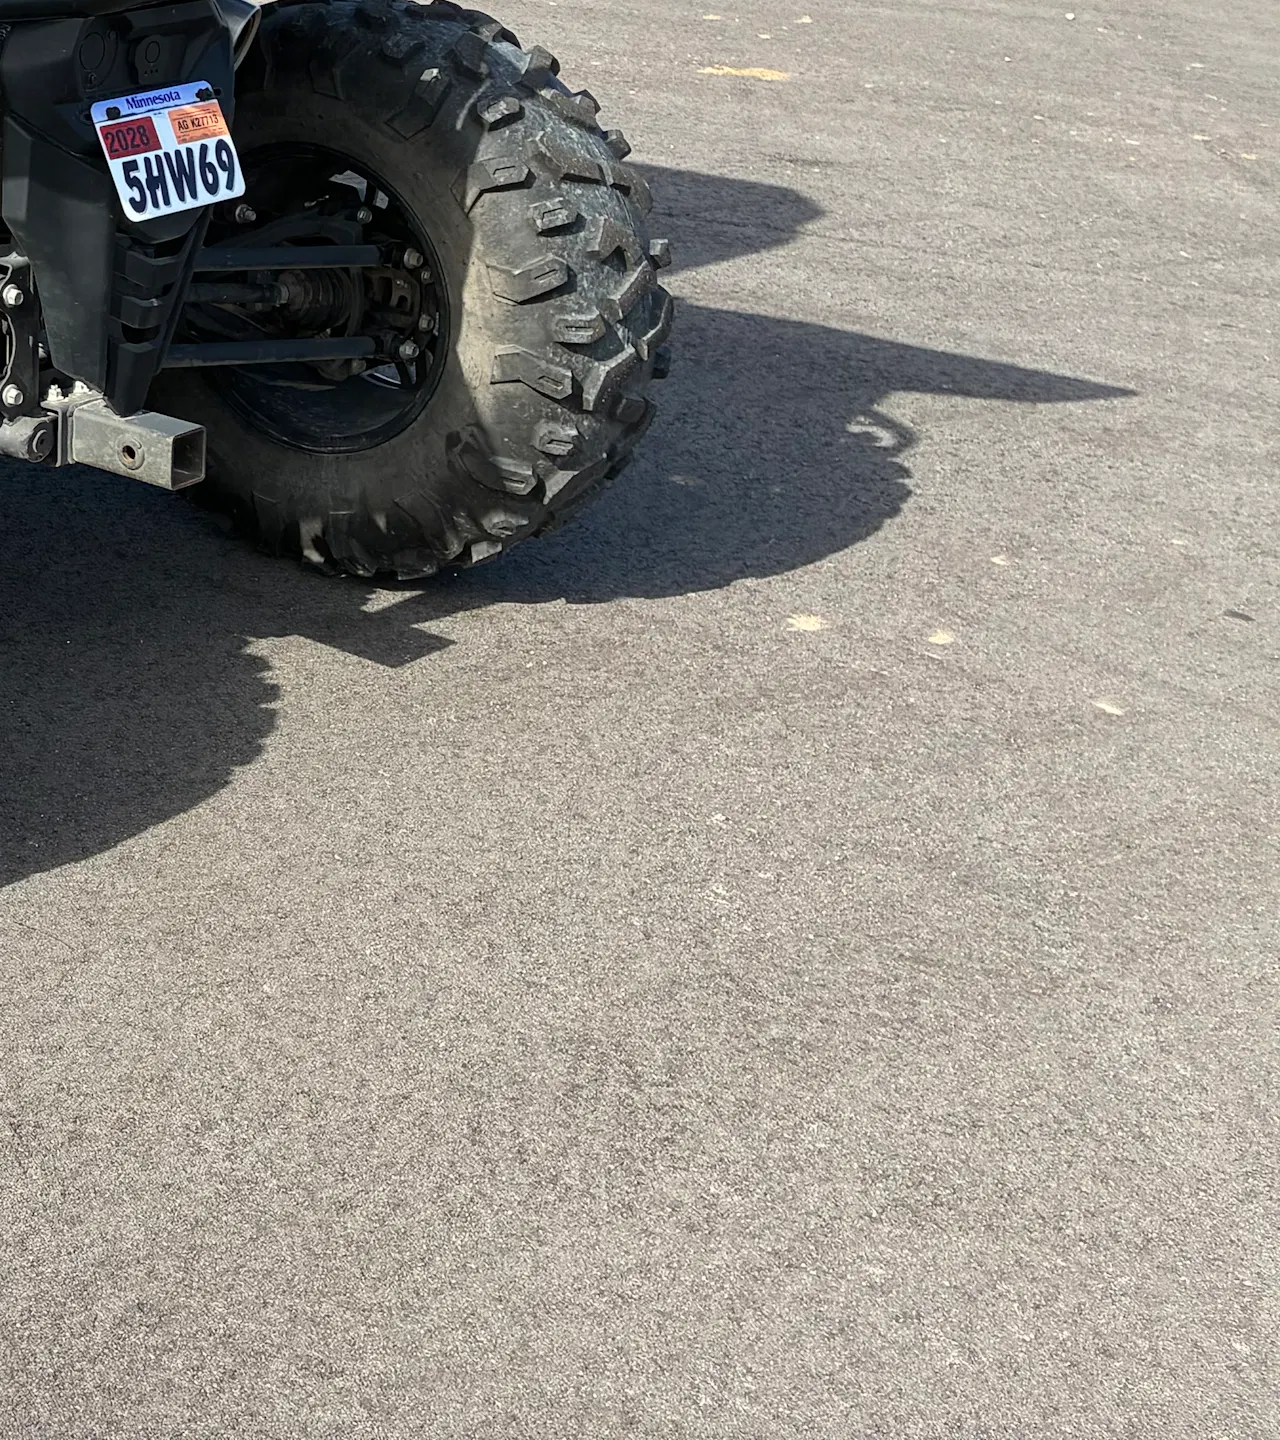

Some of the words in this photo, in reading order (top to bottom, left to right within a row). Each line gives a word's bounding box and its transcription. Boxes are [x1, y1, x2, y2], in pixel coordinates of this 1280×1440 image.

[125, 89, 182, 110] Minnesota
[177, 118, 189, 131] AG
[104, 124, 151, 154] 2028
[122, 138, 236, 215] 5HW69
